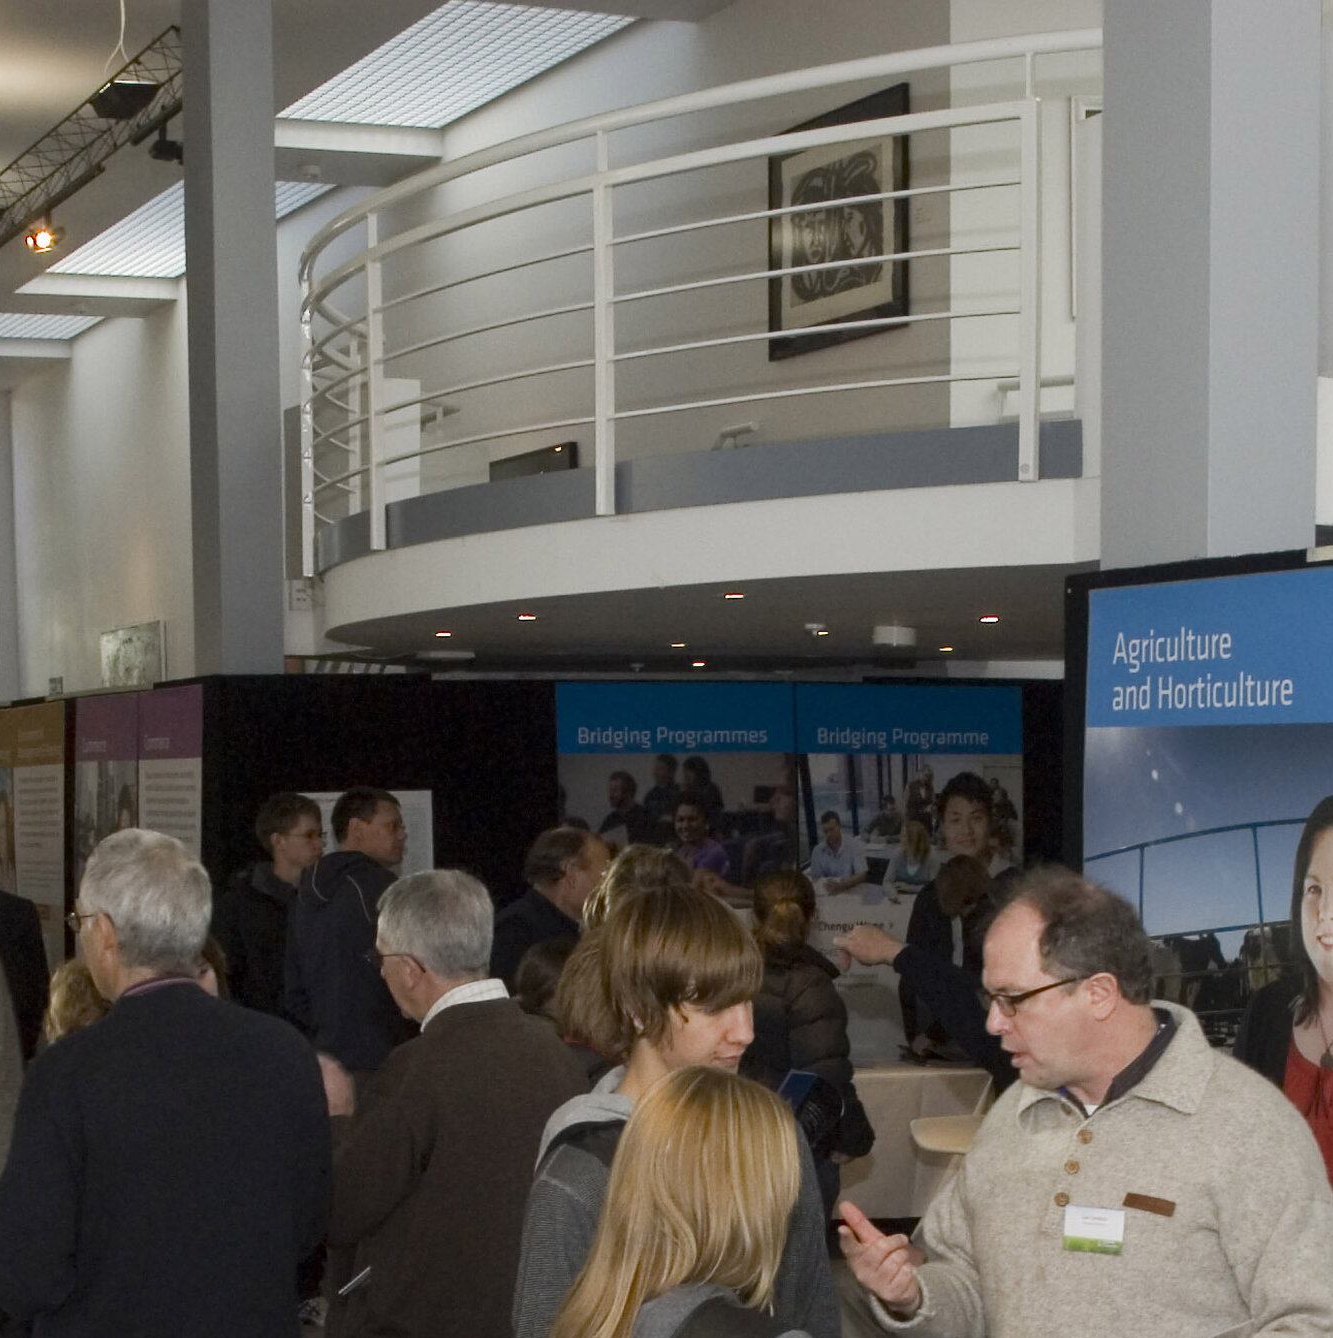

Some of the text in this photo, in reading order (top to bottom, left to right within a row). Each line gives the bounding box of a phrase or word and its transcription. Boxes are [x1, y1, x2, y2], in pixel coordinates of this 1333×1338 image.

[1112, 628, 1233, 673] Agriculture
[1112, 670, 1294, 711] and Horticulture
[577, 726, 768, 749] Bridging Programmes
[817, 727, 989, 750] Bridging Programme
